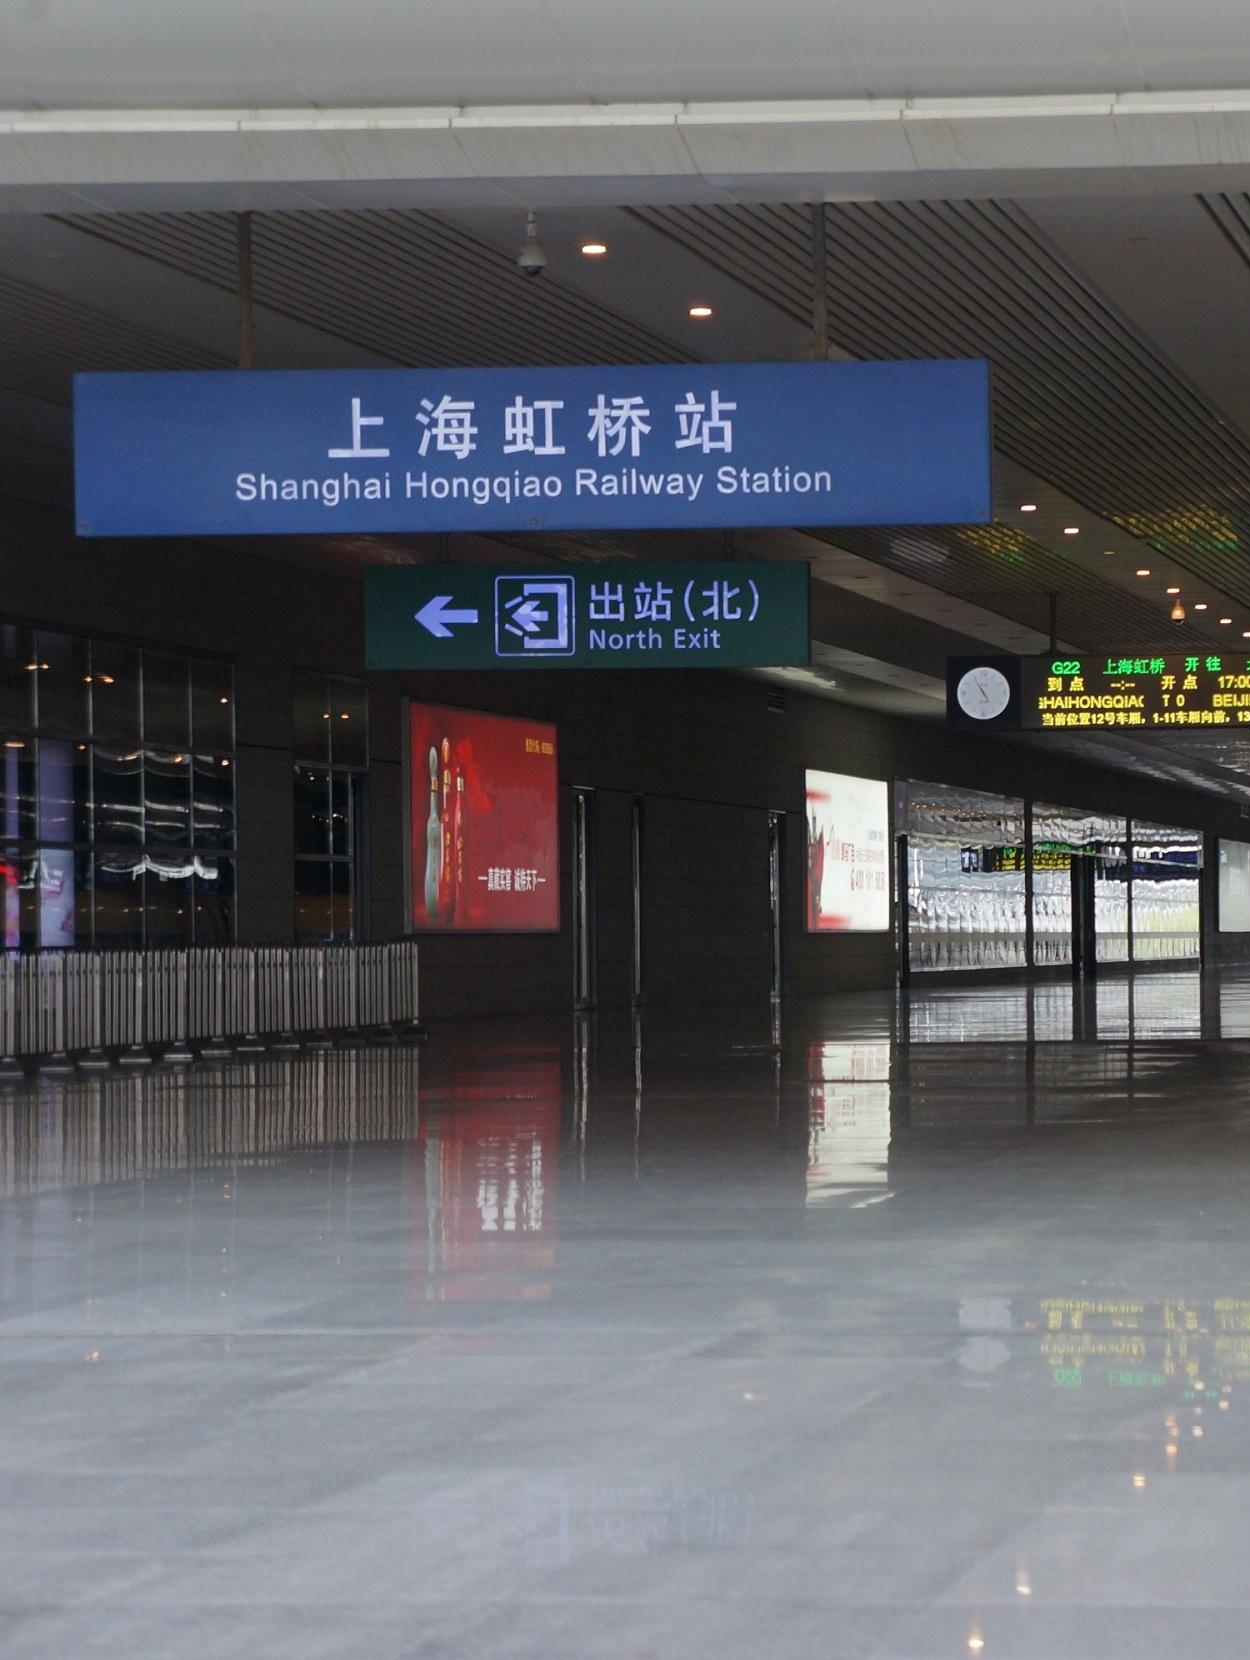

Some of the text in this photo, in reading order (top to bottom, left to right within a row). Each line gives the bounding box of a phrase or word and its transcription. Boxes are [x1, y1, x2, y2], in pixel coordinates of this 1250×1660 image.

[328, 390, 738, 460] 上海虹桥站
[235, 465, 833, 507] Shanghai Hongqiao Railway Station
[589, 627, 721, 650] North Exit
[1051, 661, 1081, 675] G22
[1102, 658, 1165, 675] 上海虹桥
[1184, 656, 1222, 672] 开往
[1047, 676, 1084, 692] 到点
[1161, 674, 1198, 690] 开点
